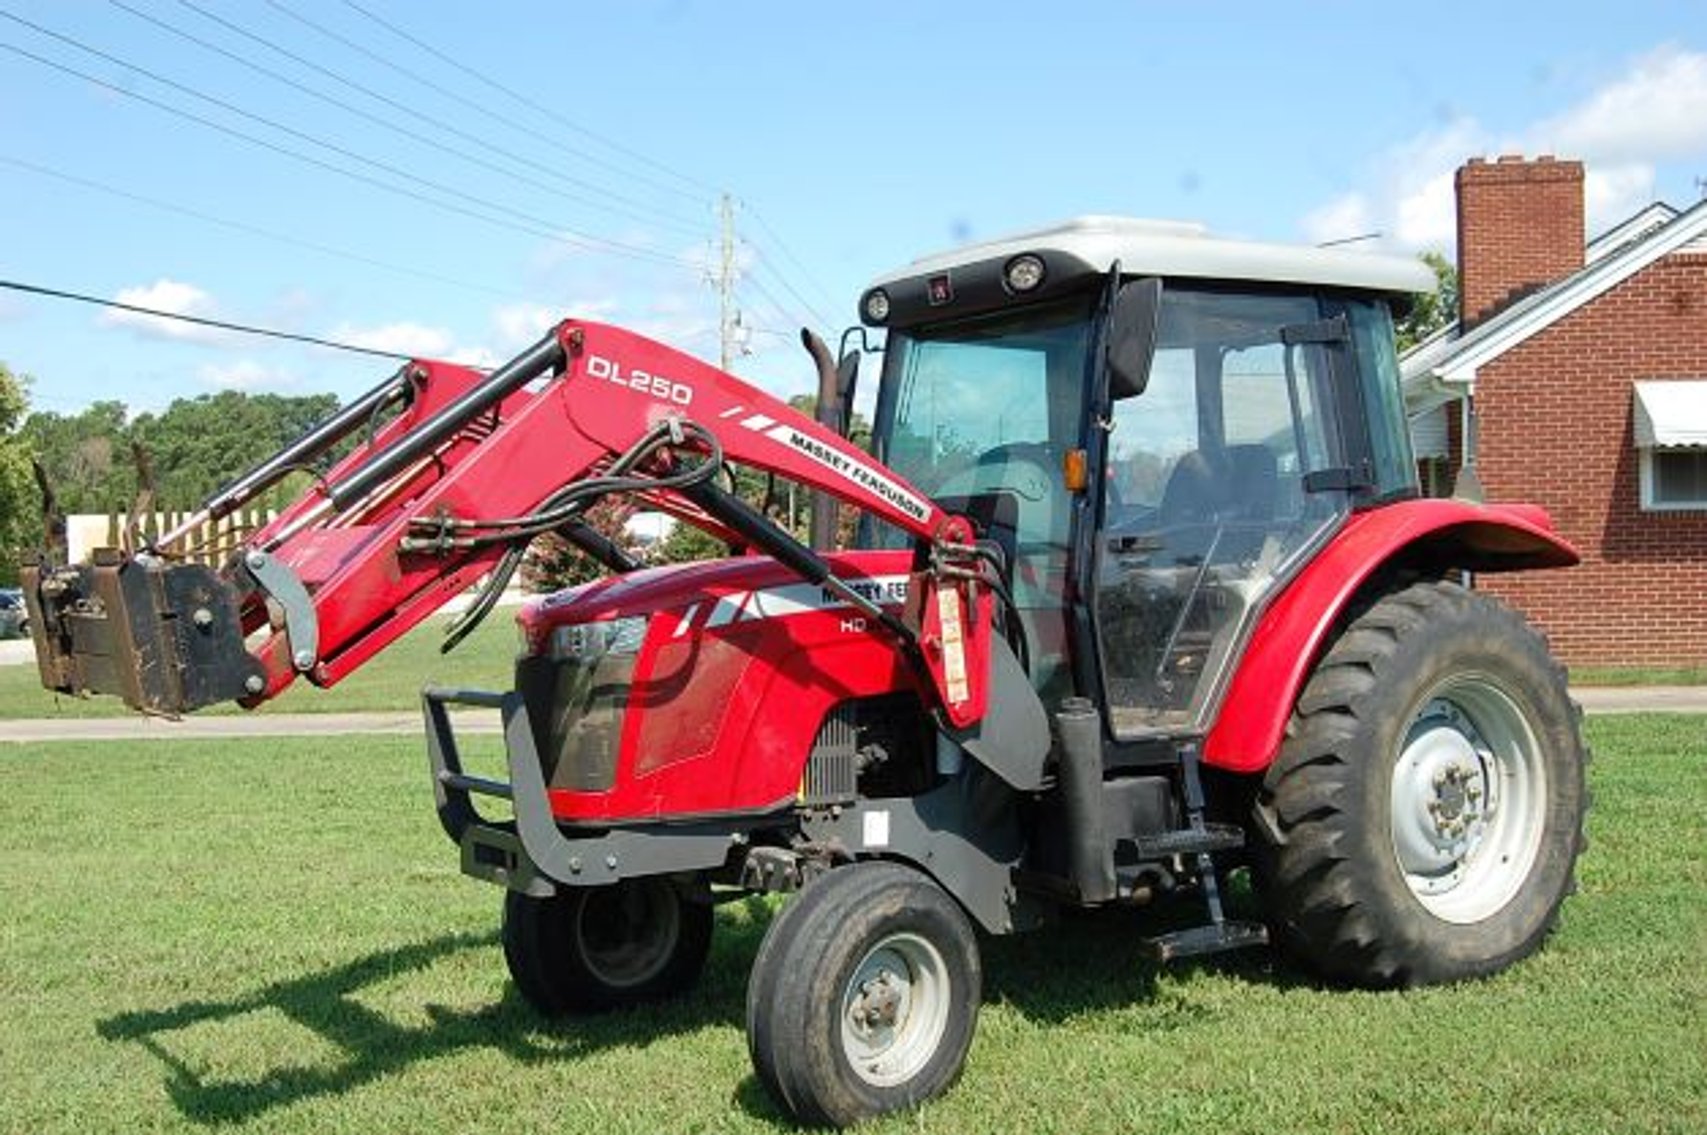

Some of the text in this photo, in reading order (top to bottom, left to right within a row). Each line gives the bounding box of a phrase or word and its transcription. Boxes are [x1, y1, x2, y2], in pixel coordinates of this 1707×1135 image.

[587, 355, 692, 405] DL250
[790, 433, 924, 518] MASSEY FERGUSON
